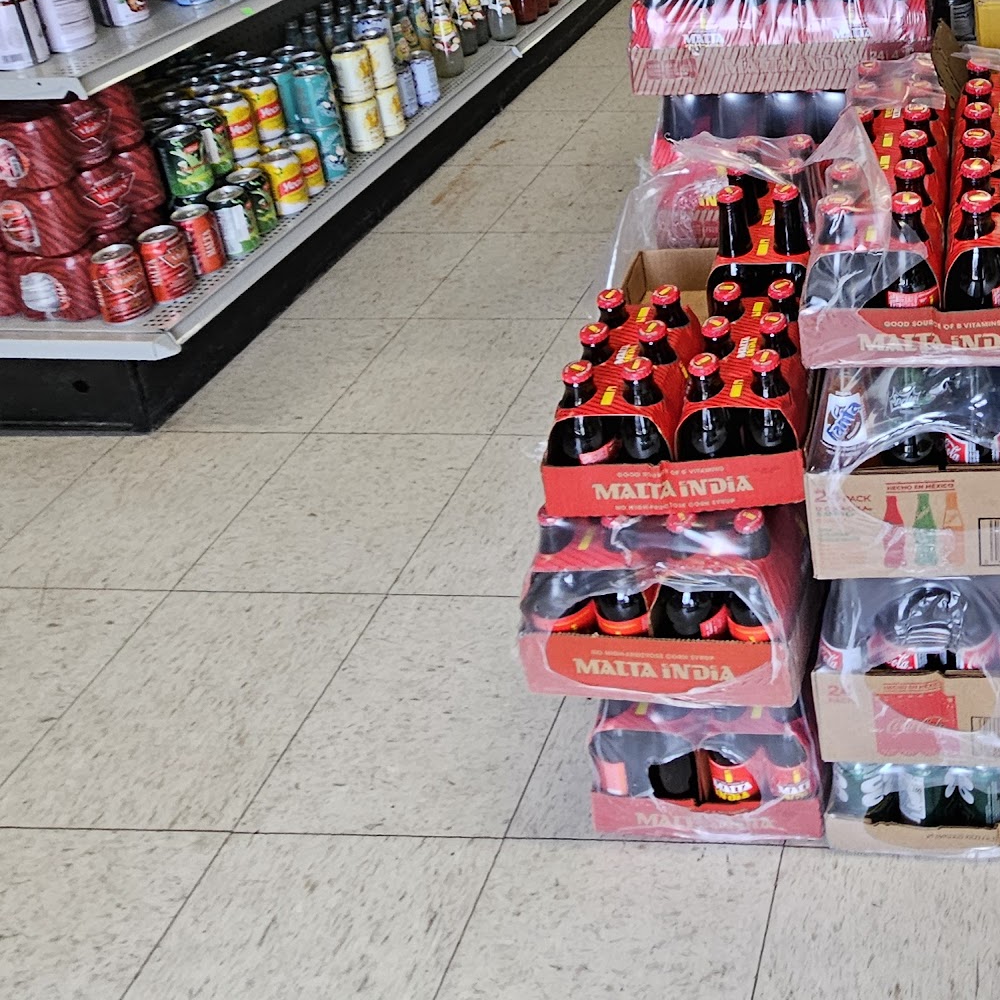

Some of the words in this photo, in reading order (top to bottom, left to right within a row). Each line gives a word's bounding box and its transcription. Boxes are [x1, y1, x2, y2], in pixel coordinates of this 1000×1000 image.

[884, 320, 909, 328] GOOD
[943, 321, 954, 329] OF
[857, 332, 942, 352] MALTA
[826, 401, 862, 441] Fanta
[592, 479, 677, 501] MALTA
[845, 494, 871, 502] PACK
[572, 658, 658, 679] MALTA
